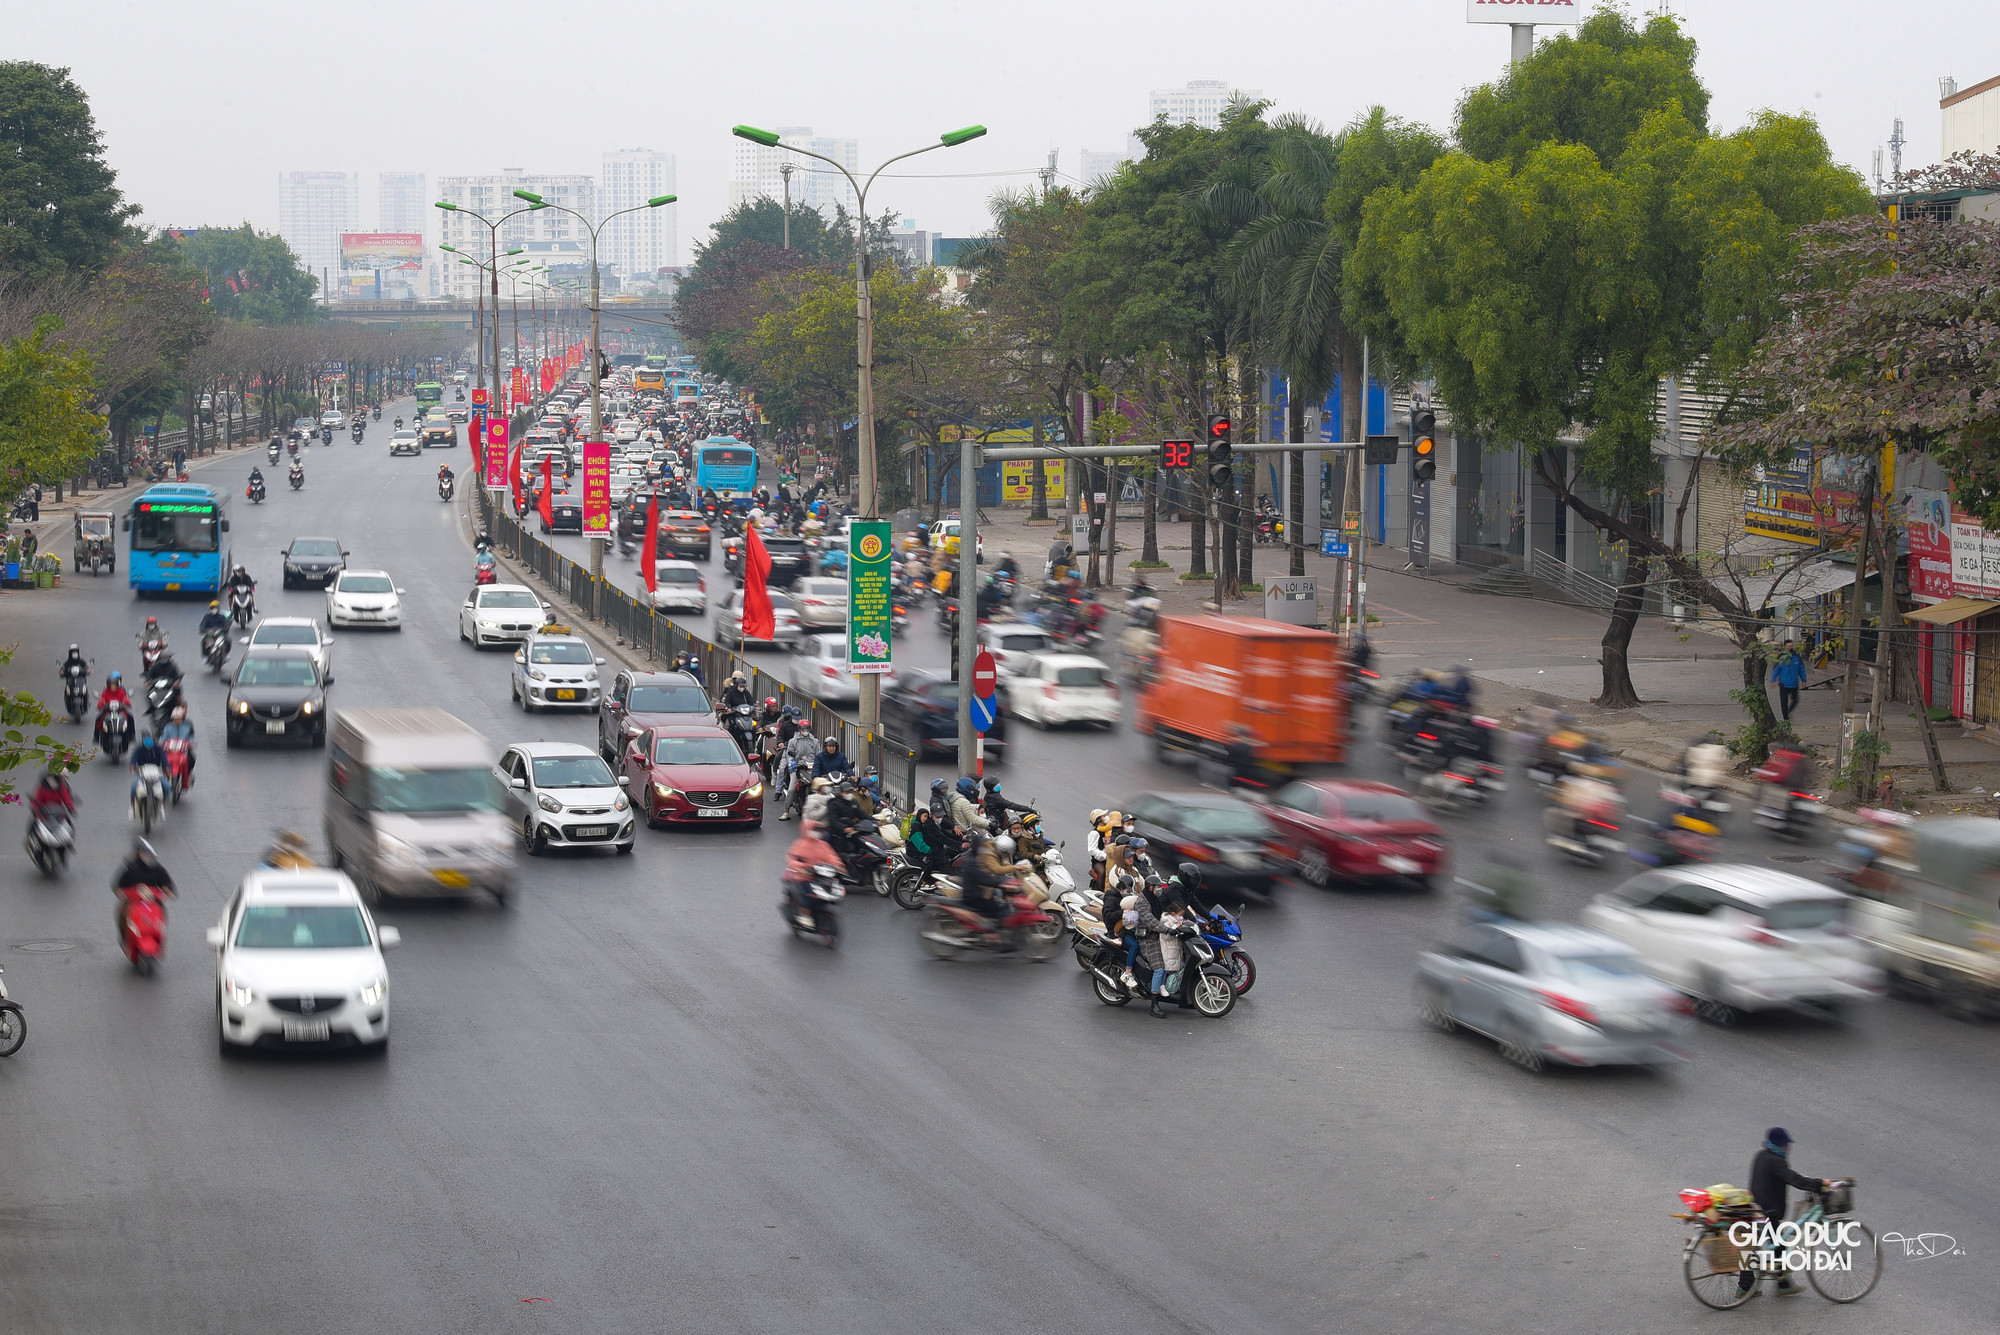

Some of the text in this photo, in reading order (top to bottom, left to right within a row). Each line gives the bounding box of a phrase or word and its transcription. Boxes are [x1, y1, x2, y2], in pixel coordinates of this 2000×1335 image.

[587, 456, 606, 465] CHÚC
[1165, 442, 1191, 467] 32
[1345, 517, 1359, 530] LỐP
[1960, 556, 1968, 569] XE
[1969, 557, 1979, 570] GA
[1983, 560, 1991, 573] XE
[1303, 582, 1314, 591] RA
